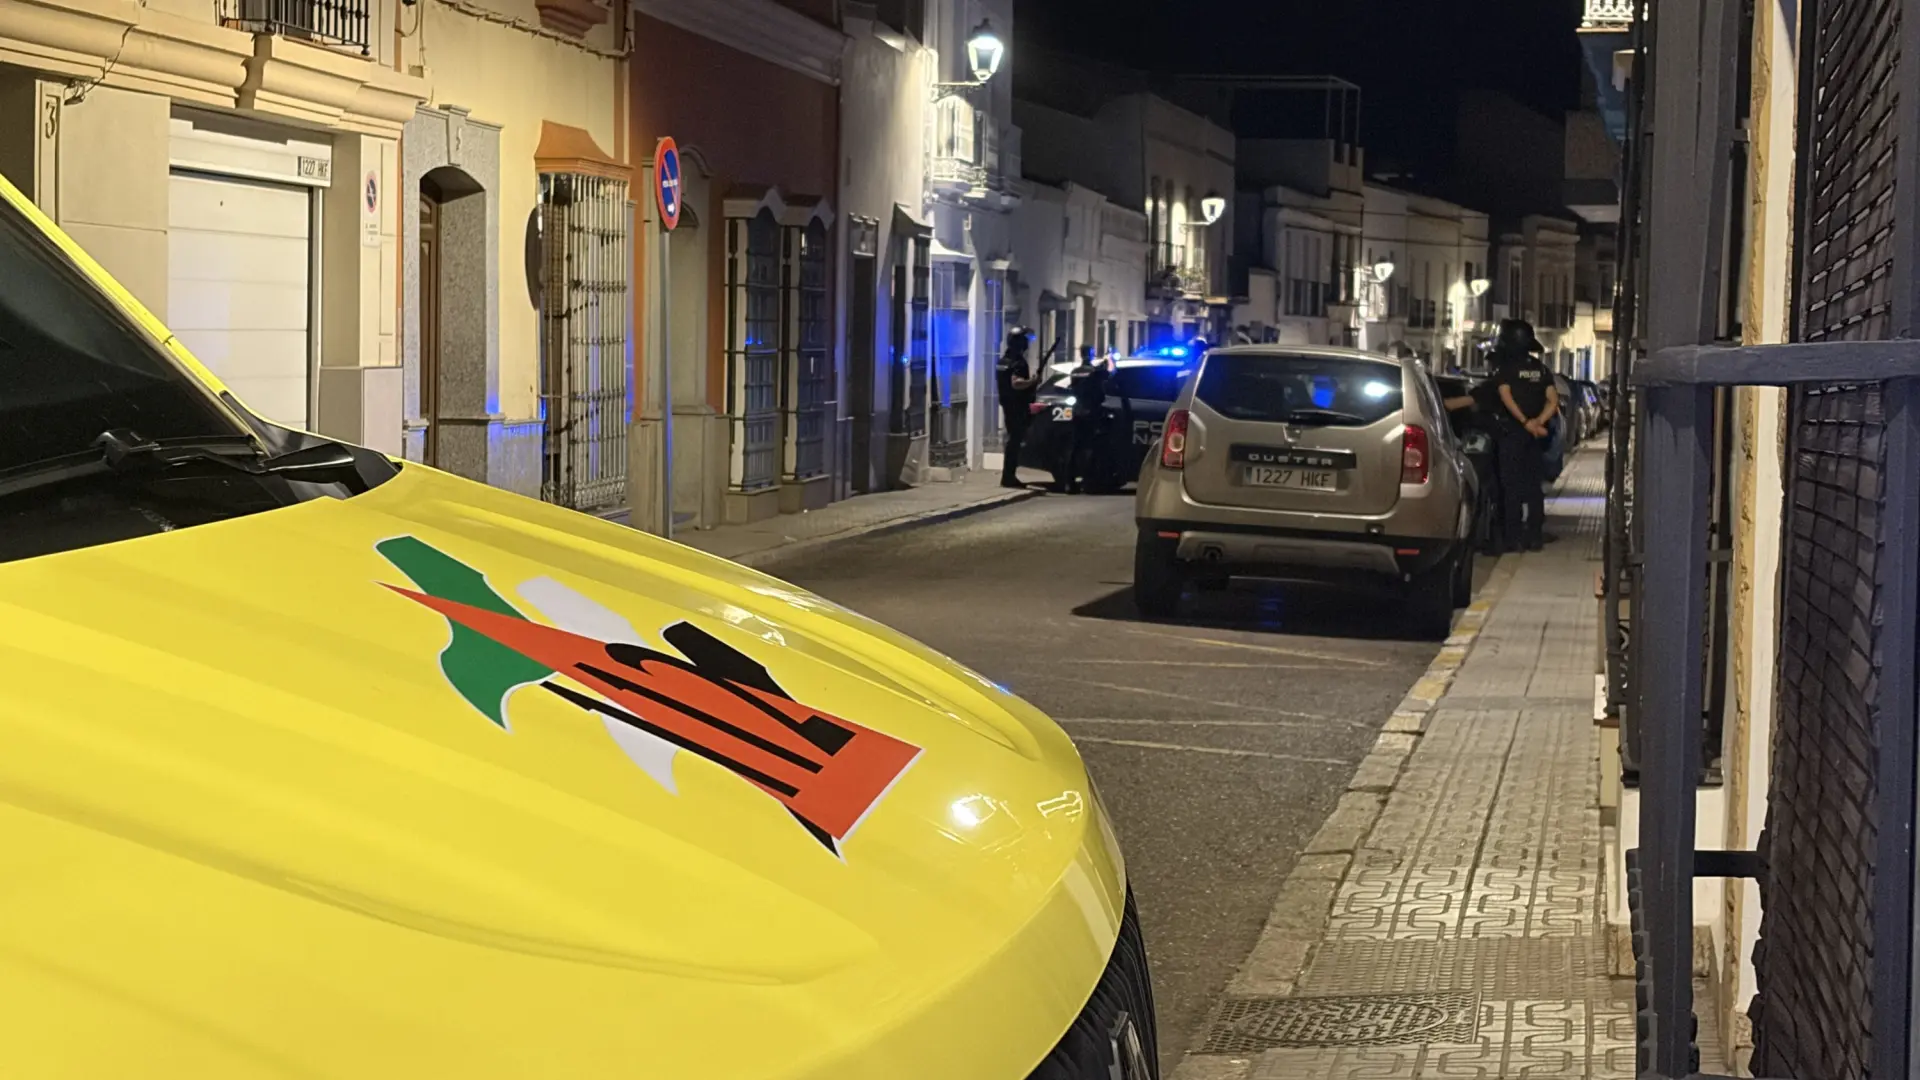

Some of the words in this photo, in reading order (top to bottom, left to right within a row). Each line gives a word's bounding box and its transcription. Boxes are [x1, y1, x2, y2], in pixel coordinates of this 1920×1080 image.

[44, 101, 56, 140] 3
[1248, 453, 1333, 466] DUSTER
[1255, 468, 1293, 484] 1227
[1300, 472, 1331, 487] HKF
